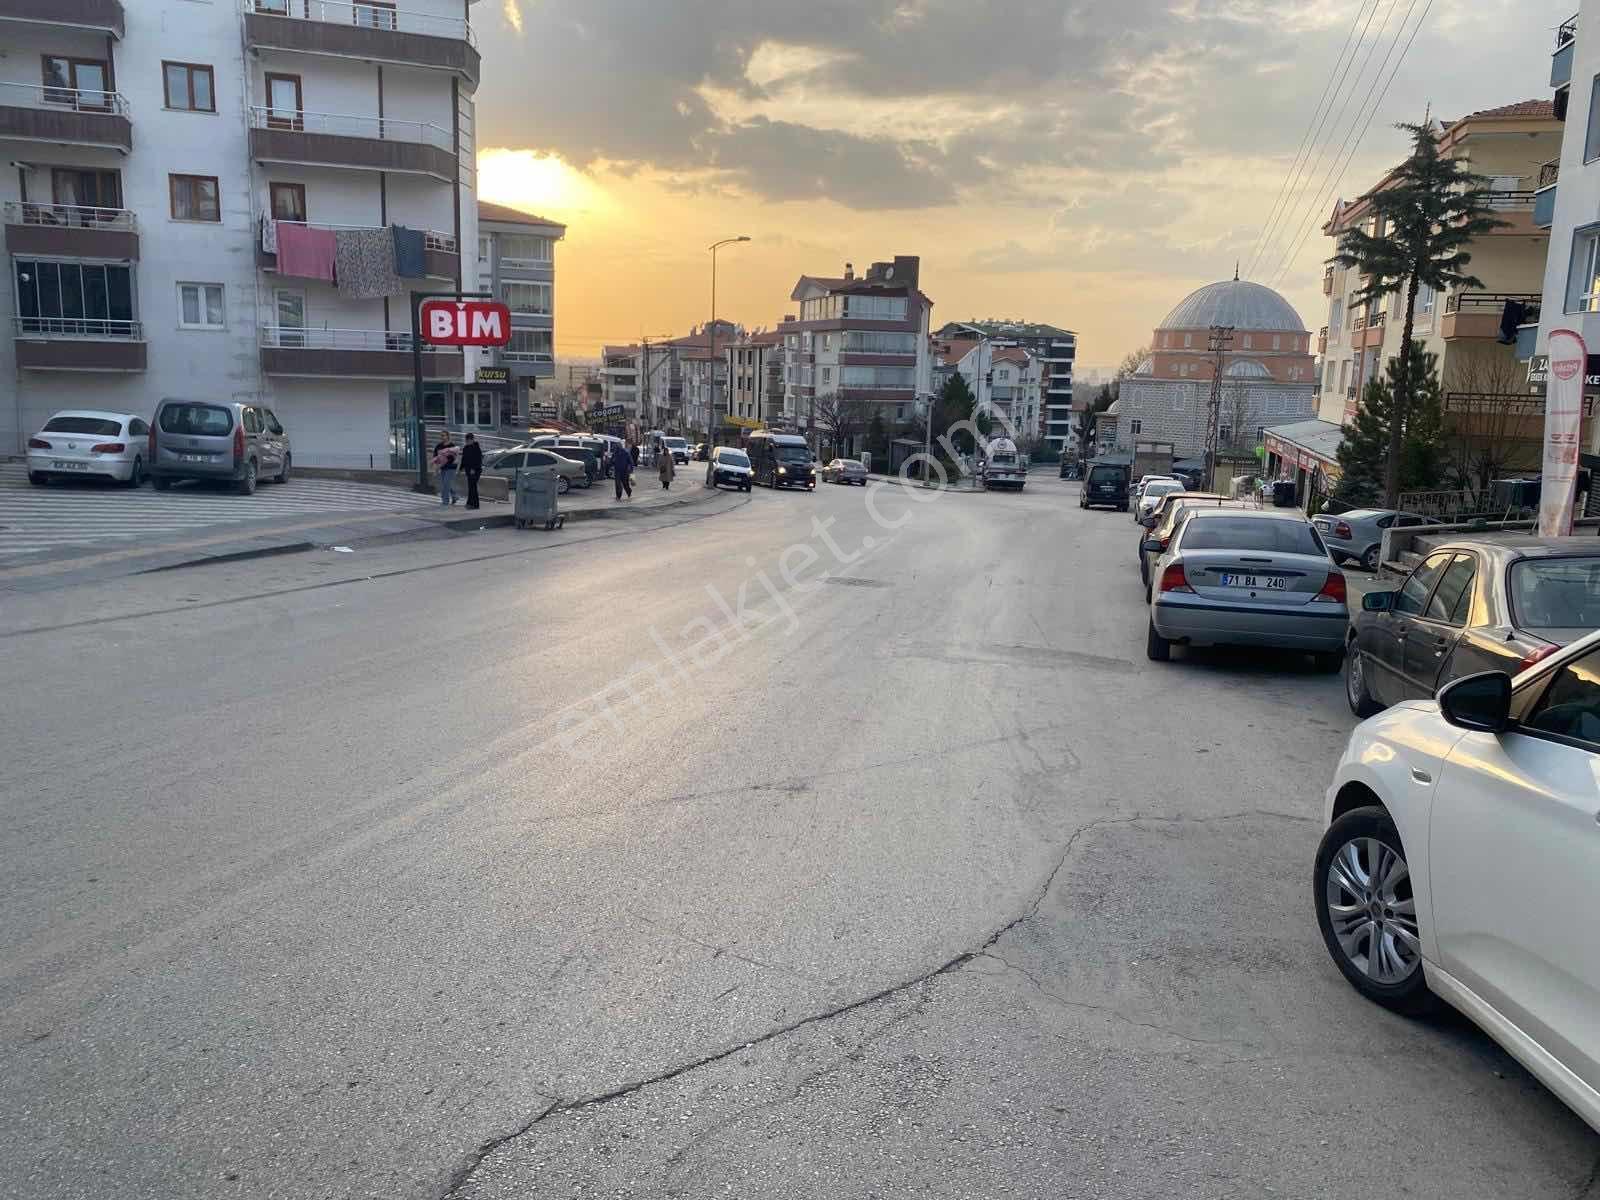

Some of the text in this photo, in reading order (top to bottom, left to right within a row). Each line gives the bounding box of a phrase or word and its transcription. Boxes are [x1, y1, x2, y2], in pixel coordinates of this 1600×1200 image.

[430, 303, 502, 338] BİM
[1228, 575, 1239, 585] 71
[1267, 577, 1285, 588] 240
